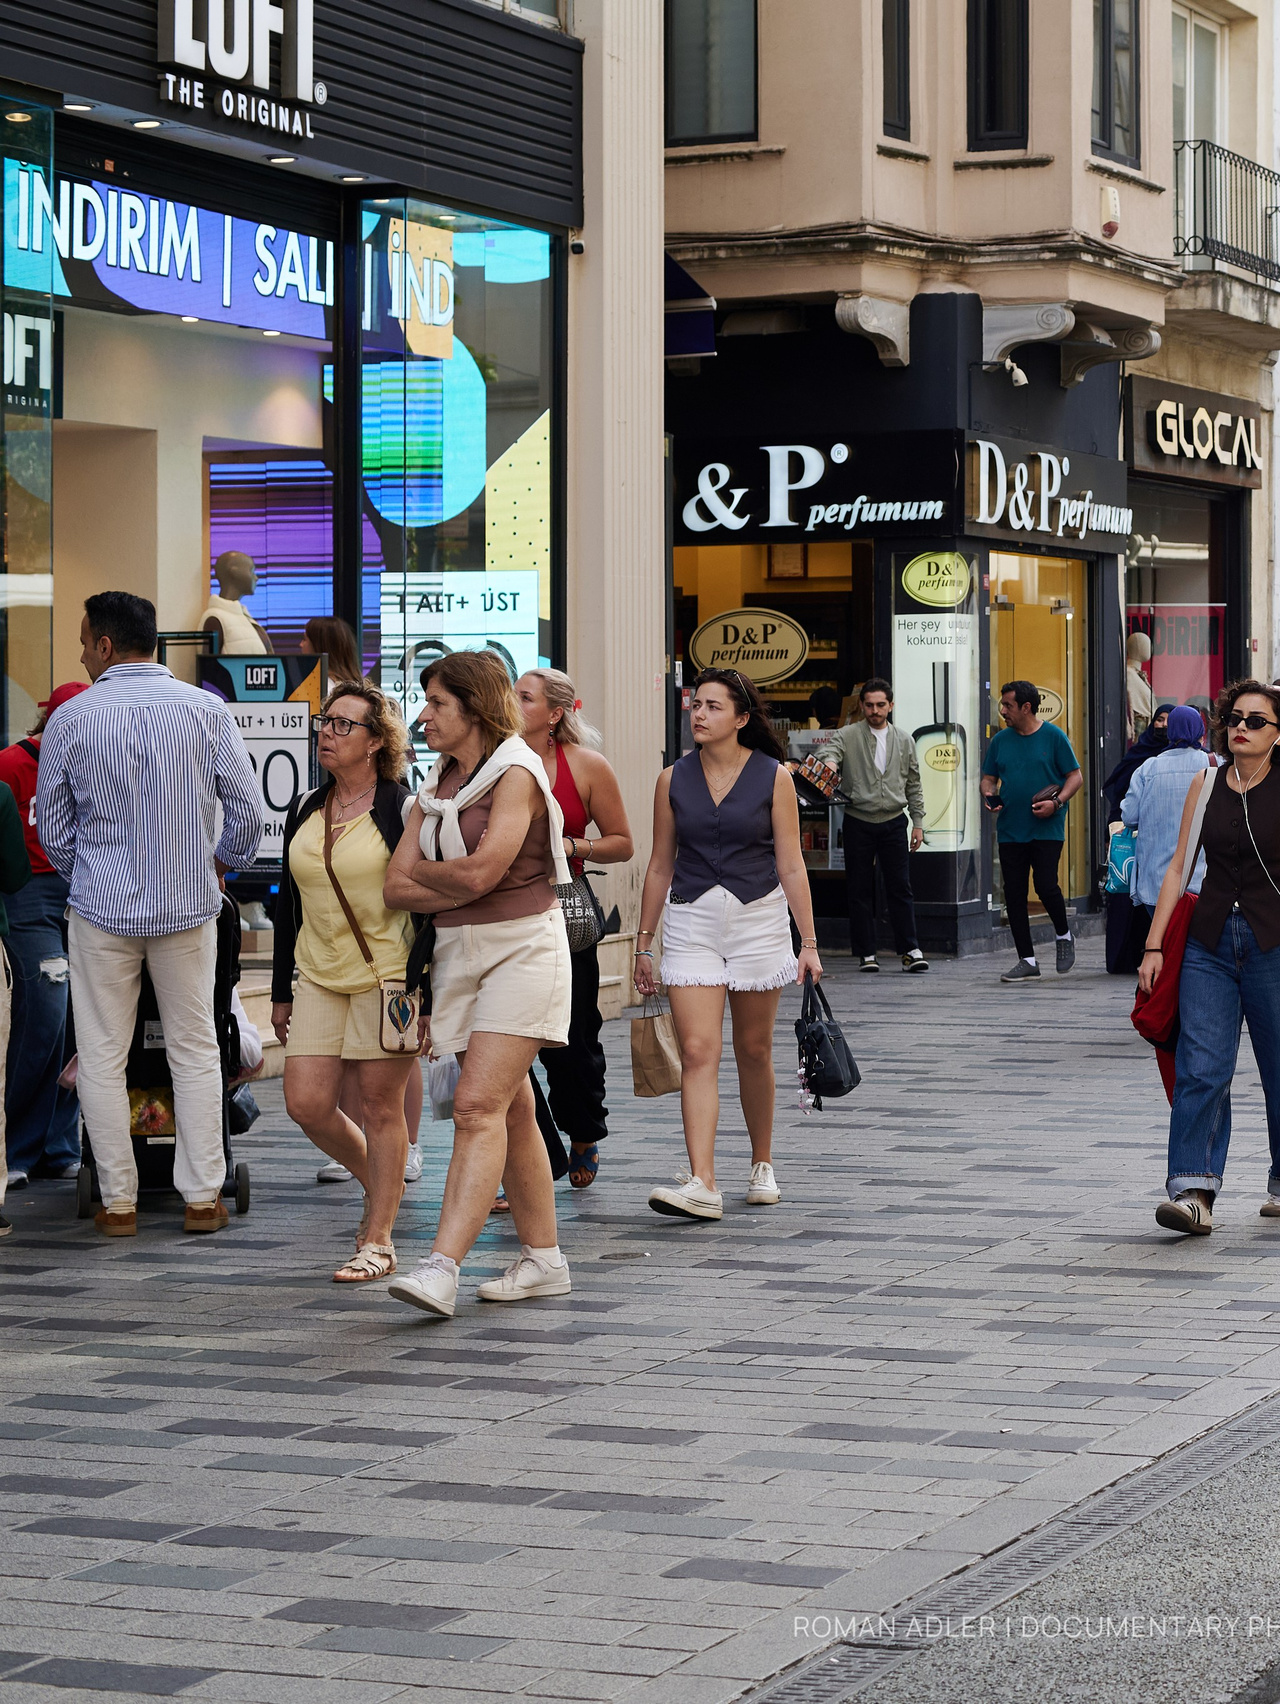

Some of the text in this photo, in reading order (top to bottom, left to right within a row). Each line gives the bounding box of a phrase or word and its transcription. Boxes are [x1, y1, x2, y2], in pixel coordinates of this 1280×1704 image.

[165, 72, 315, 140] THE ORIGINAL
[252, 222, 335, 307] SAL
[7, 393, 48, 408] RIGINA
[1156, 399, 1263, 471] GLOCAL
[804, 495, 944, 531] perfumum
[1056, 489, 1133, 540] perfumum
[720, 622, 777, 646] D&P
[897, 619, 918, 630] Her
[920, 620, 941, 632] şey
[906, 635, 953, 646] kokunuz
[709, 645, 790, 666] perfumum
[246, 667, 276, 685] LOFT
[281, 713, 304, 728] ÜST
[248, 749, 300, 813] 0
